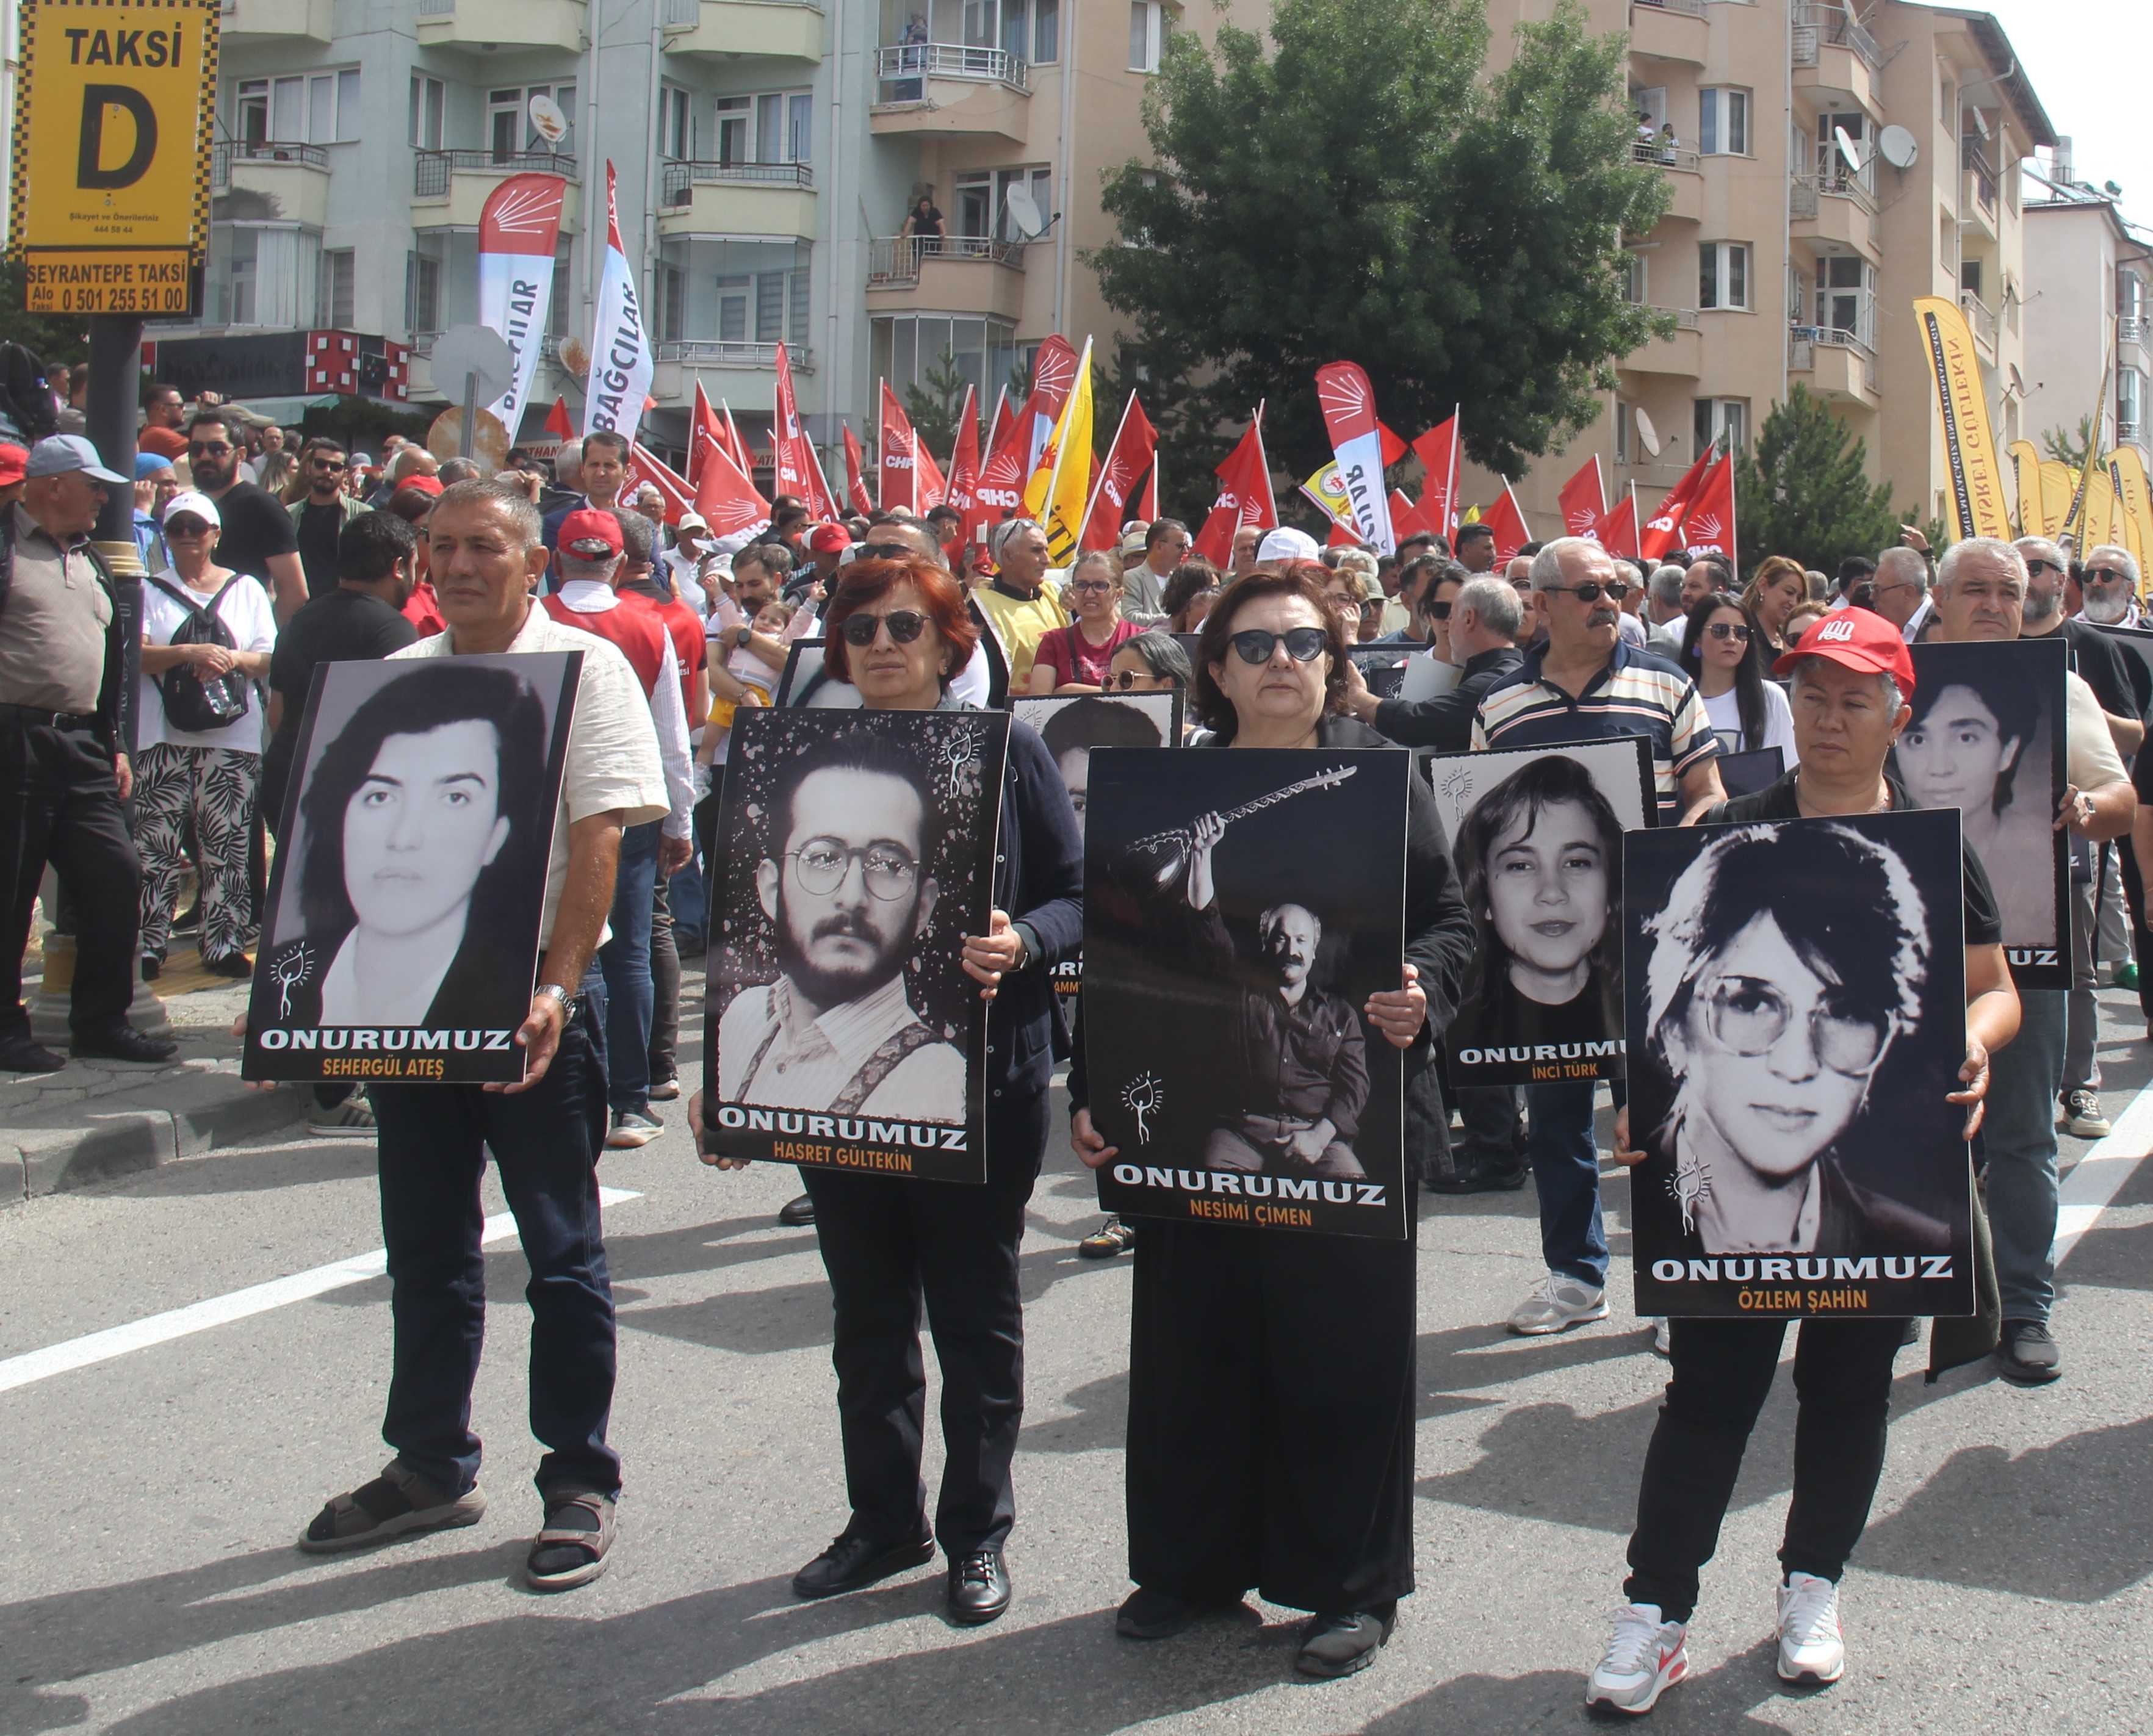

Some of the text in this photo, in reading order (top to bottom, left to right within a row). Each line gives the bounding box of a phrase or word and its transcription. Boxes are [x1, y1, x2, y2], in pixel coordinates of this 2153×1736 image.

[65, 22, 182, 68] TAKSİ
[77, 84, 158, 190] D
[70, 212, 99, 222] Şikayet
[26, 259, 186, 284] SEYRANTEPE TAKSİ
[33, 286, 182, 311] Alo 0 501 255 51 00
[592, 282, 640, 433] BAĞCILAR
[1104, 479, 1124, 508] CHP
[260, 1029, 511, 1050] ONURUMUZ
[323, 1054, 444, 1080] SEHERGÜL ATEŞ
[1532, 1061, 1598, 1079] İNCİ TÜRK
[718, 1107, 967, 1151] ONURUMUZ
[774, 1140, 912, 1172] HASRET GÜLTEKİN
[1113, 1164, 1387, 1206] ONURUMUZ
[1191, 1198, 1313, 1227] NESİMİ ÇİMEN
[1651, 1256, 1953, 1281] ONURUMUZ
[1738, 1285, 1868, 1314] ÖZLEM ŞAHİN
